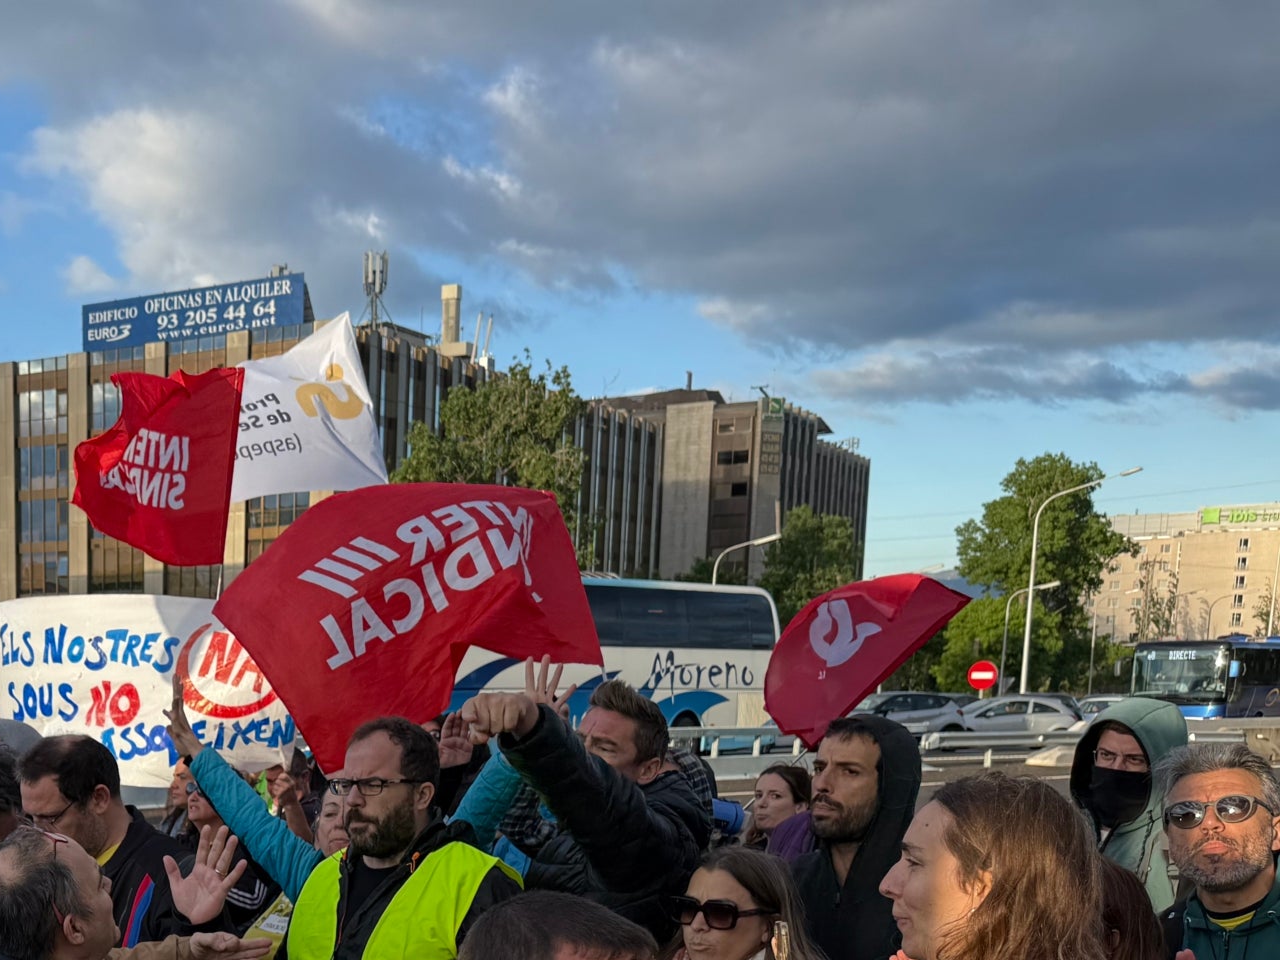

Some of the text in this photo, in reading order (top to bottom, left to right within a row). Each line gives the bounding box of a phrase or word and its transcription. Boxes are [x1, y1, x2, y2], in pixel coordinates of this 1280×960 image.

[144, 279, 292, 314] OFICINAS EN ALQUILER
[88, 306, 138, 324] EDIFICIO
[157, 299, 277, 330] 93 205 44 64
[157, 316, 277, 341] www.euro3.net
[87, 324, 132, 343] EURO3
[1229, 508, 1258, 523] ibis
[0, 622, 180, 674] ELS NOSTRES
[1168, 650, 1197, 660] DIRECTE
[648, 650, 754, 691] Moreno
[8, 680, 141, 728] SOUS NO
